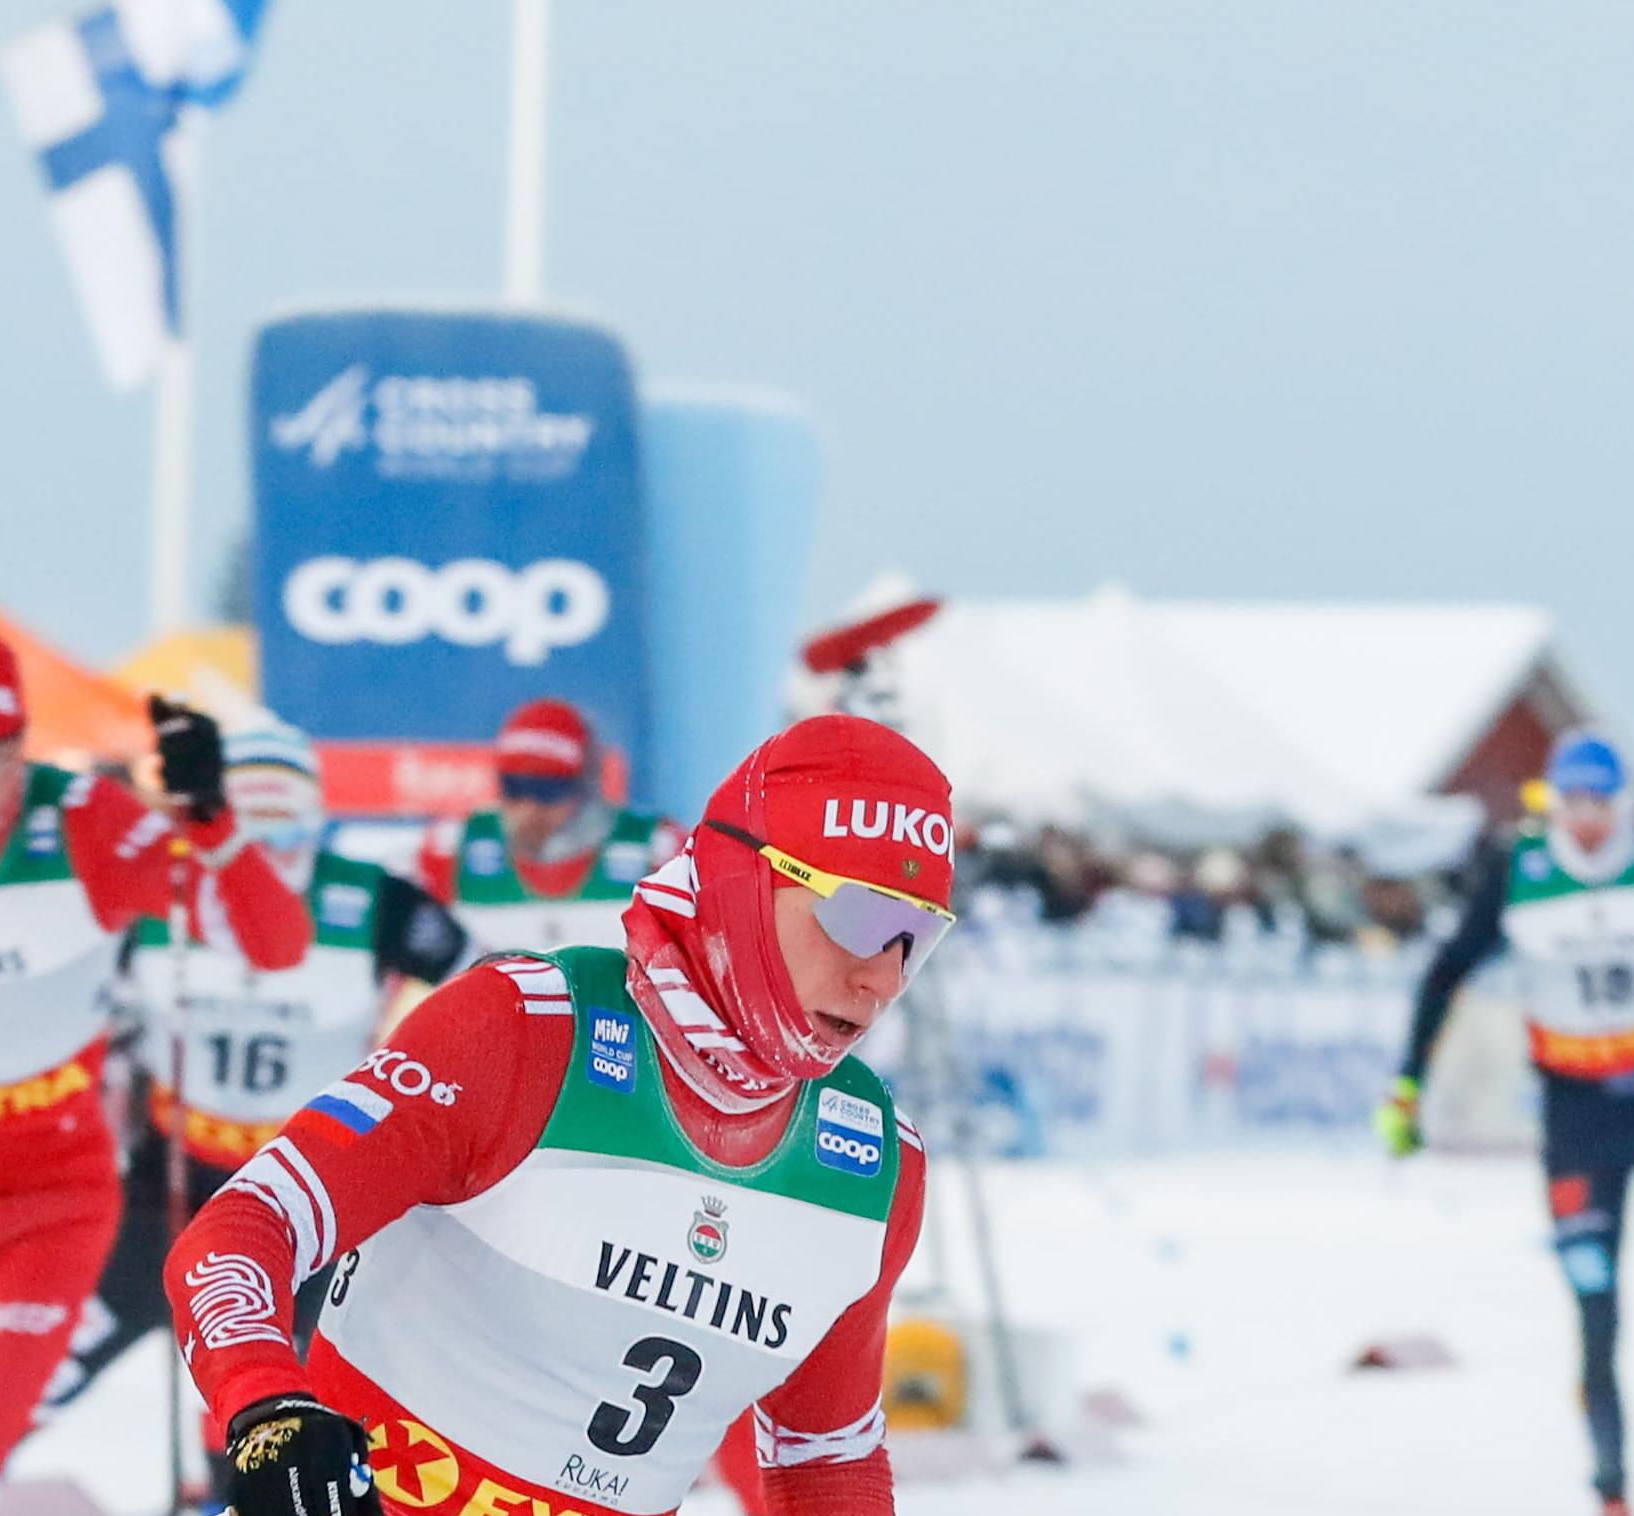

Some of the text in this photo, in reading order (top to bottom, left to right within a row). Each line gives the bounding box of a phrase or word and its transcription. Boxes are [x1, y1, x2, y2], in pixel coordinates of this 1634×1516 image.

[282, 556, 612, 666] coop
[204, 1034, 289, 1094] 16
[593, 1057, 628, 1082] coop
[818, 1131, 880, 1165] coop
[330, 1249, 361, 1308] 3
[594, 1240, 793, 1350] VELTINS
[586, 1335, 703, 1457] 3
[560, 1453, 629, 1497] RUKA!
